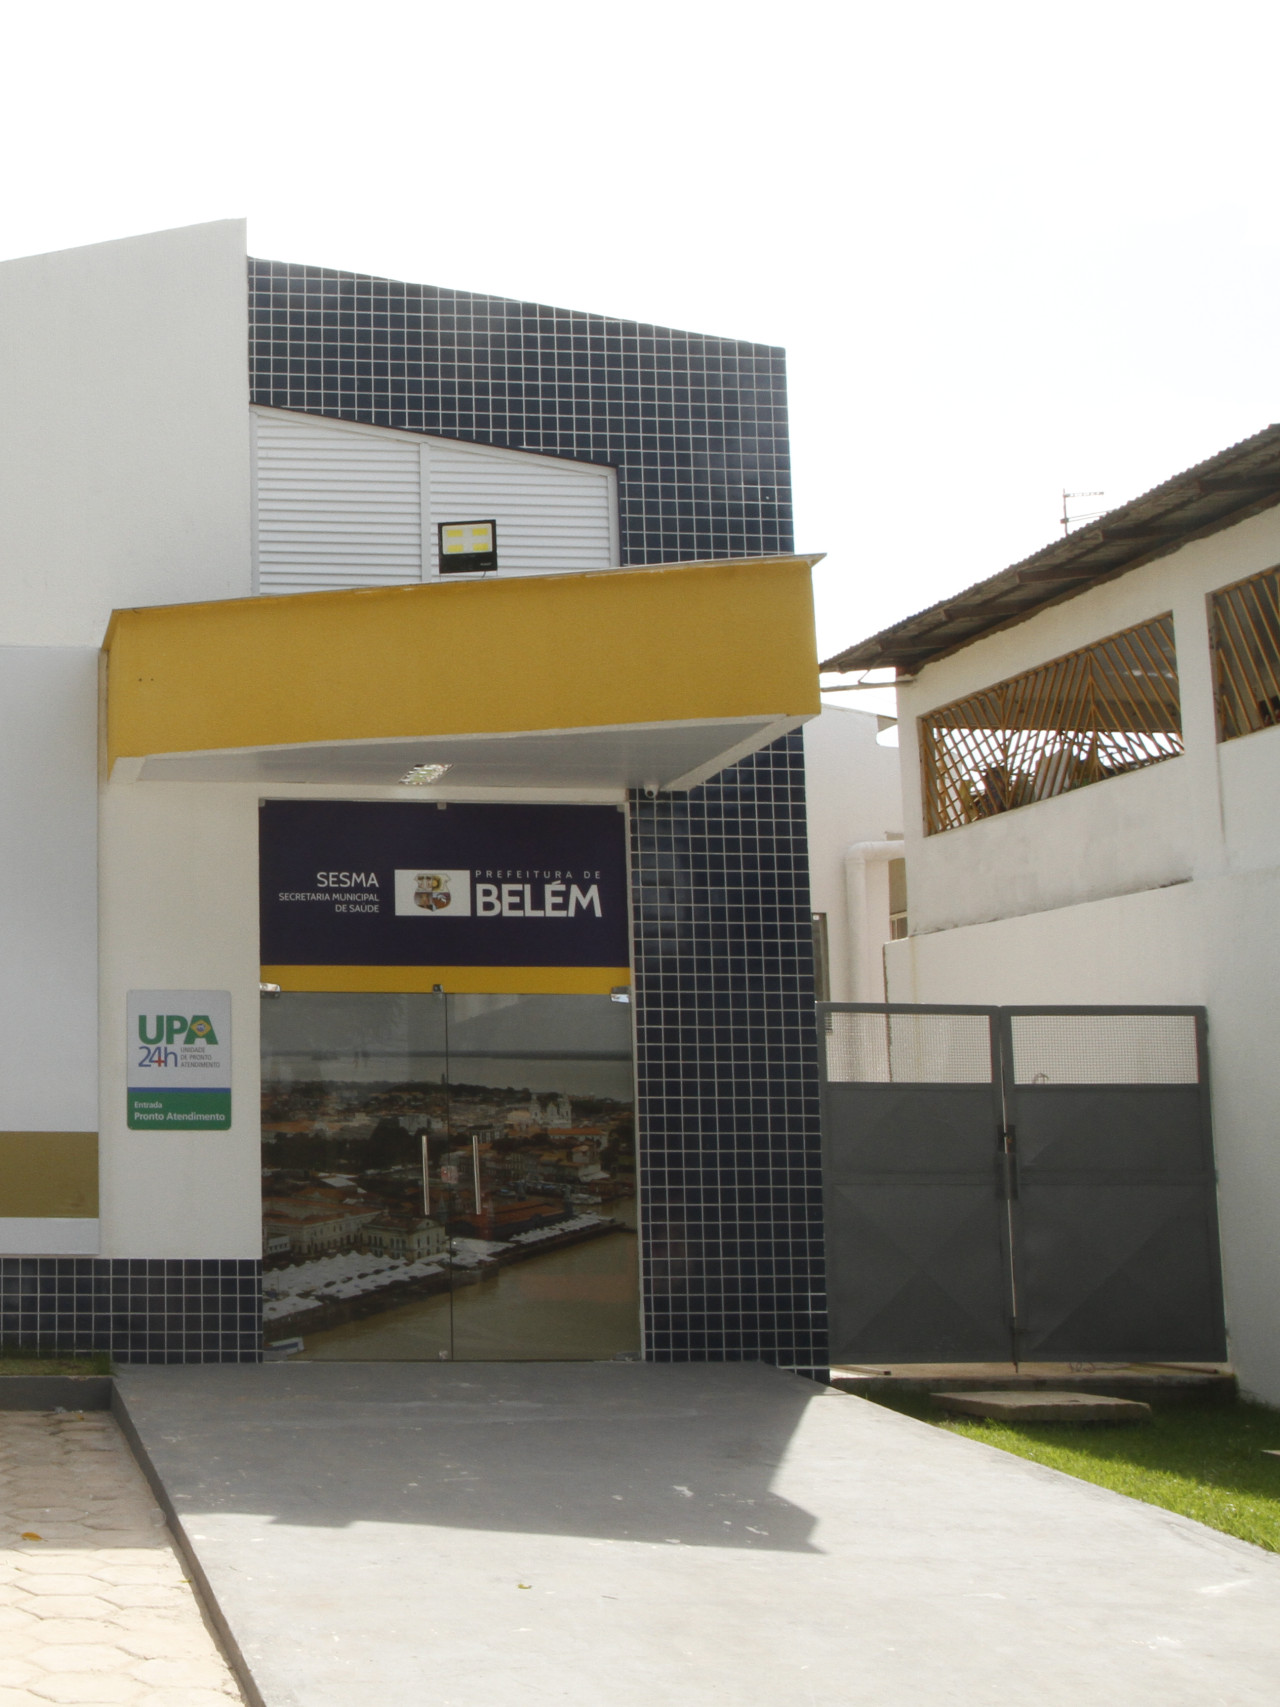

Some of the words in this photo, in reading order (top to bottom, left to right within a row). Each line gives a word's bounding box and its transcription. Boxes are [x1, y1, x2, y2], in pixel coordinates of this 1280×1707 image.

[316, 871, 380, 888] SESMA
[475, 870, 573, 879] PREFEITURA
[583, 871, 601, 879] DE
[278, 892, 331, 902] SECRETARIA
[332, 892, 380, 902] MUNICIPAL
[475, 880, 603, 918] BELÉM
[334, 904, 348, 913] DE
[348, 902, 380, 914] SAÚDE
[138, 1015, 219, 1045] UPA
[138, 1045, 178, 1068] 24h
[134, 1101, 163, 1109] Entrada
[134, 1112, 165, 1121] Pronto
[166, 1111, 226, 1121] Atendimento
